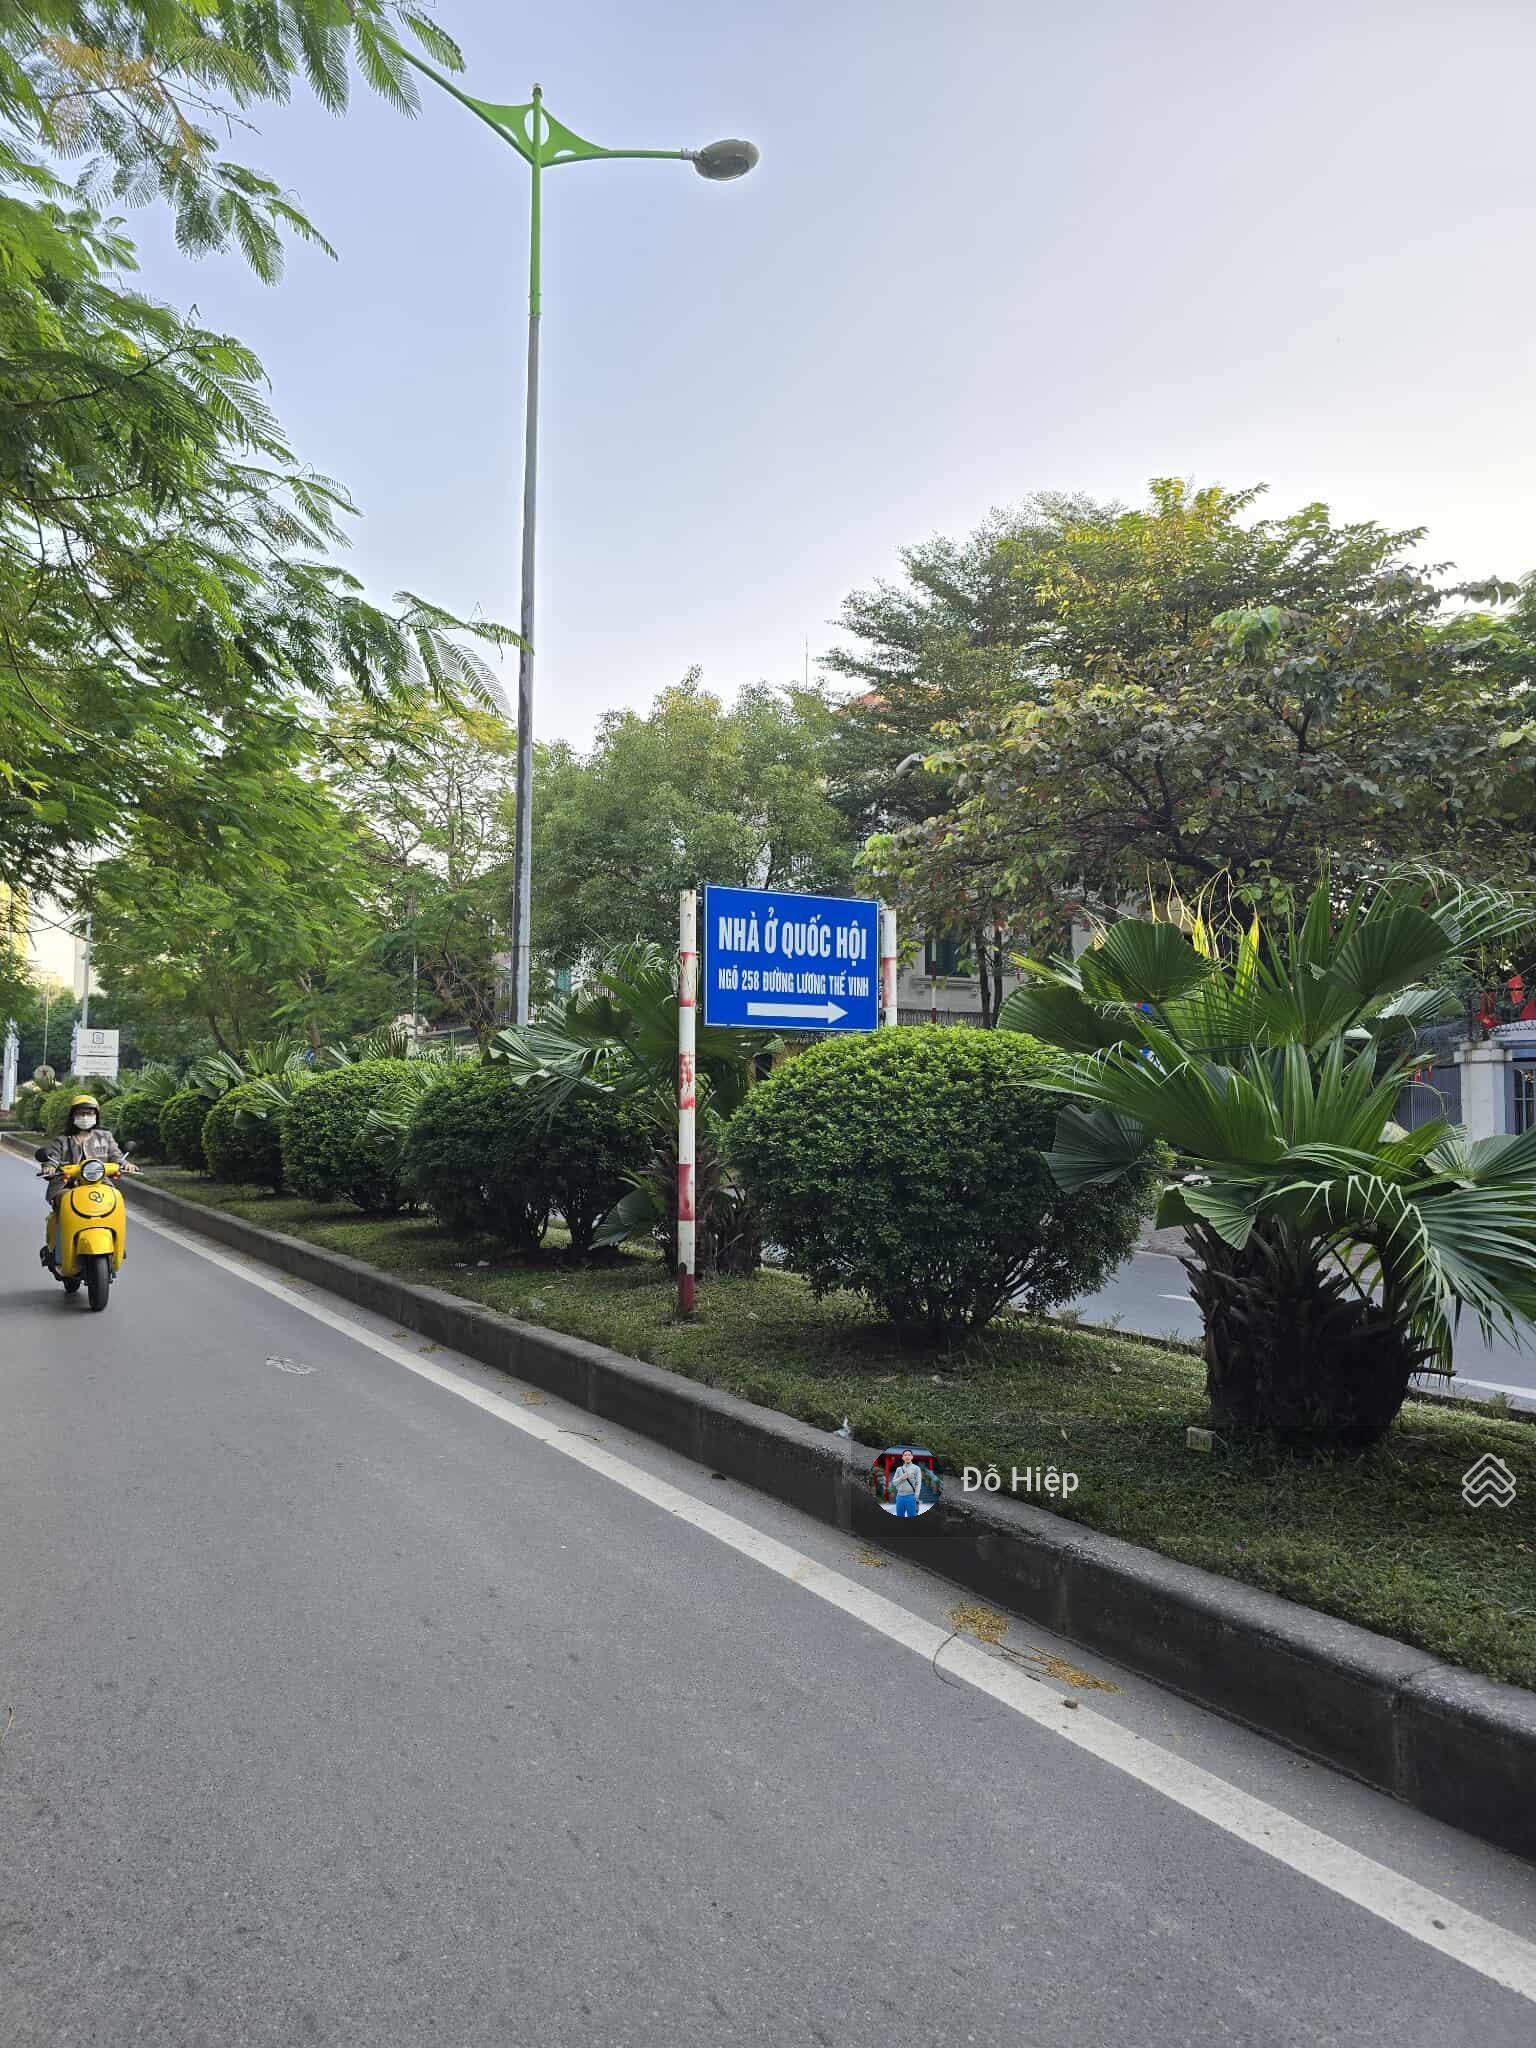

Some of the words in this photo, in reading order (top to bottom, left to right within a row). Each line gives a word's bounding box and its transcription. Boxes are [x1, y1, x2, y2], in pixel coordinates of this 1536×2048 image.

[719, 910, 760, 953] NHÀ
[764, 906, 779, 954] Ở
[782, 914, 831, 959] QUỐC
[836, 920, 867, 966] HỘI
[718, 964, 738, 990] NGÕ
[741, 969, 760, 991] 258
[762, 966, 795, 993] ĐƯỜNG
[796, 971, 826, 995] LƯƠNG
[829, 969, 846, 996] THẾ
[847, 976, 869, 997] VINH
